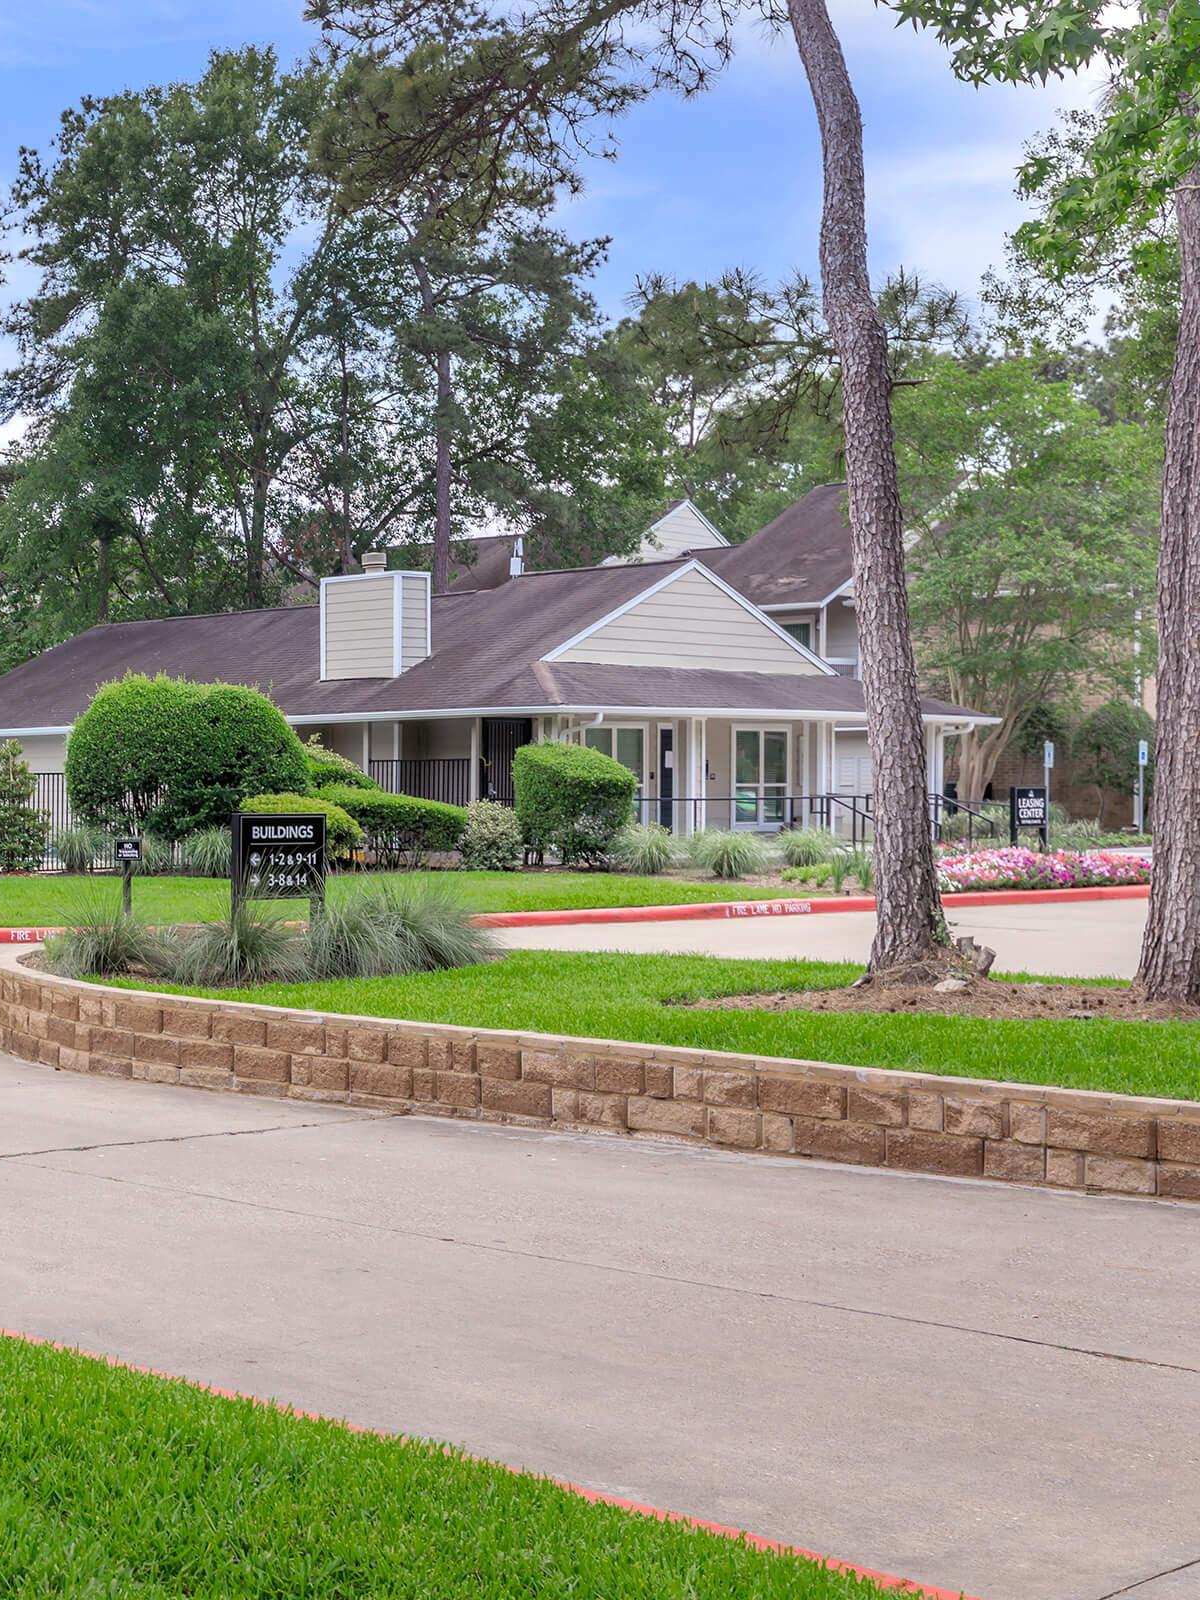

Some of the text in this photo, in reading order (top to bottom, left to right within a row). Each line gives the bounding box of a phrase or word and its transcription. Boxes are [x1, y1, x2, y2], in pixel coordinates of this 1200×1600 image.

[1018, 798, 1045, 808] LEASING
[1019, 808, 1044, 818] CENTER
[252, 825, 314, 839] BUILDINGS
[295, 852, 317, 865] 9-11
[295, 873, 307, 886] 14
[751, 904, 770, 914] LANE
[772, 903, 782, 913] NO
[784, 902, 811, 912] PARKING
[11, 930, 31, 941] FIRE
